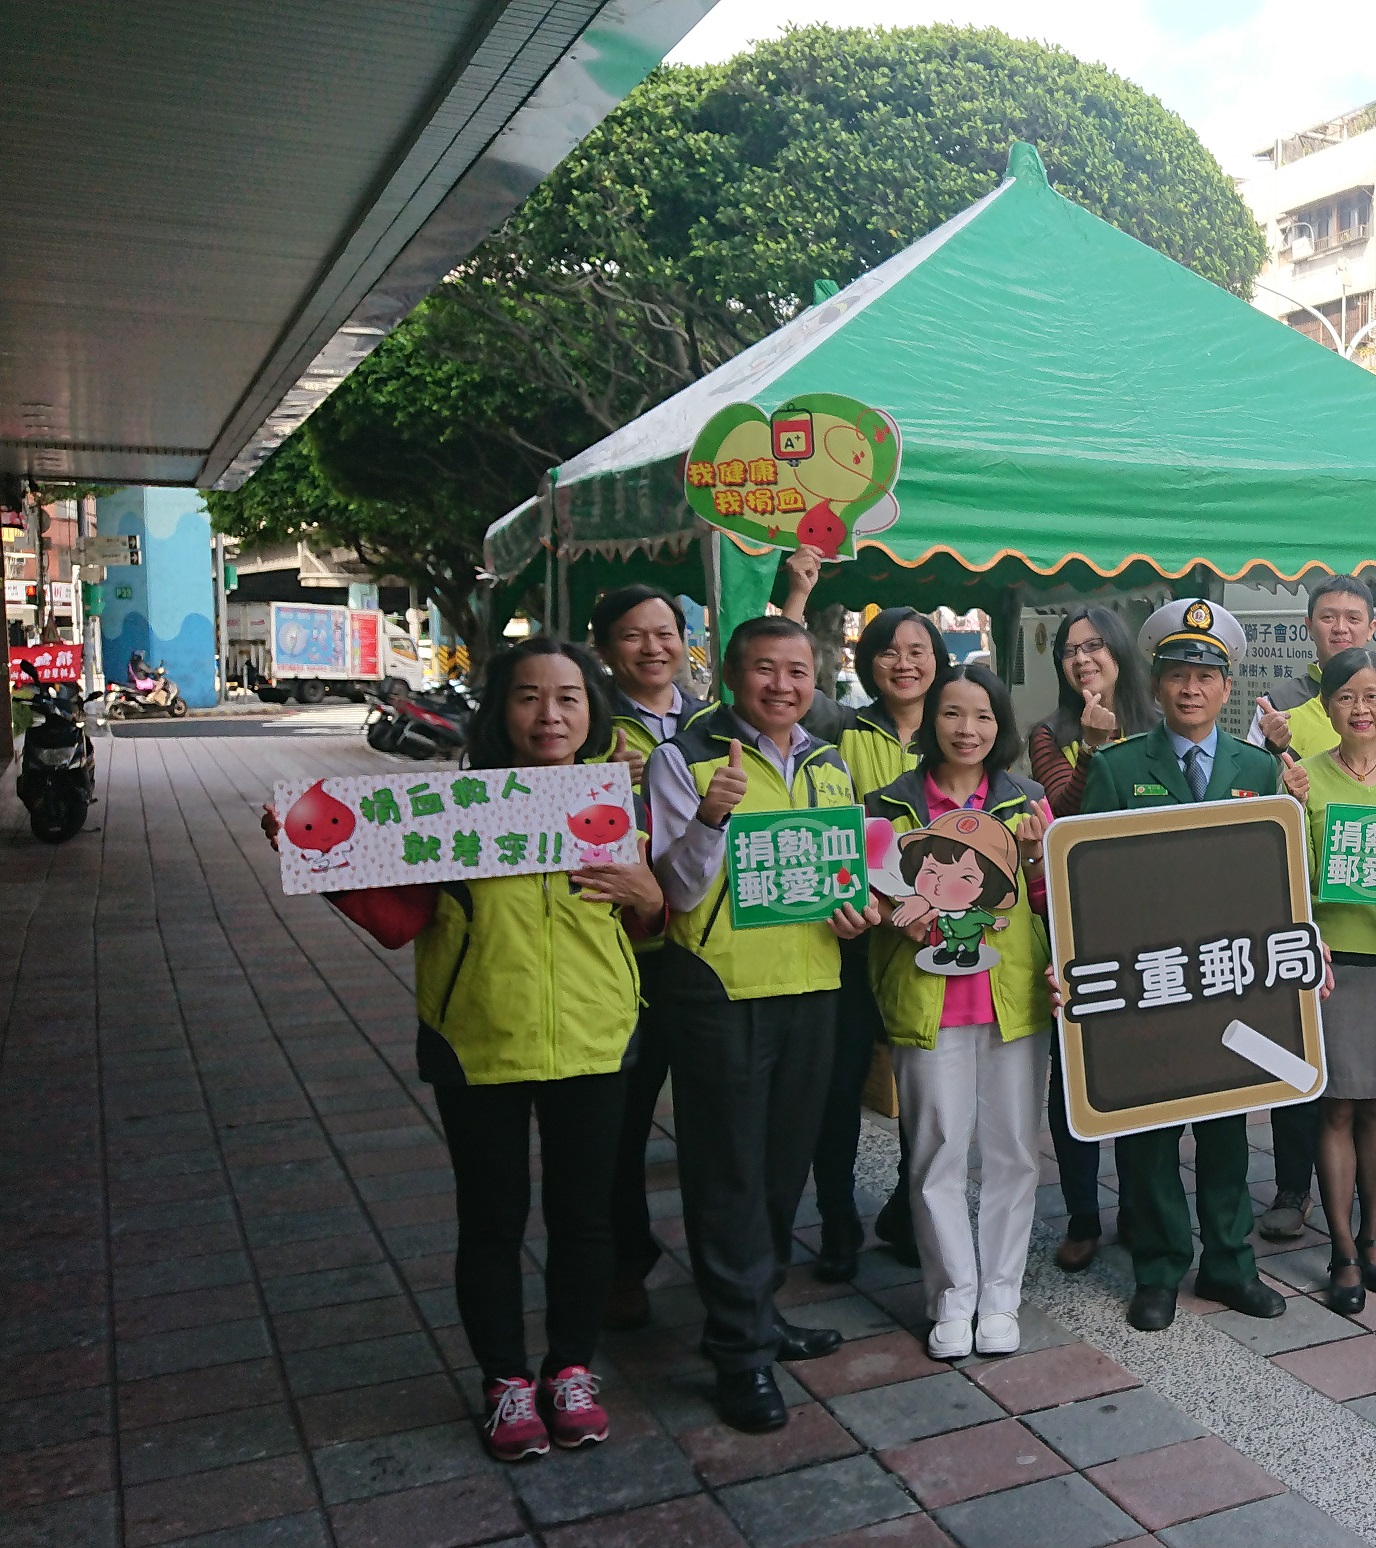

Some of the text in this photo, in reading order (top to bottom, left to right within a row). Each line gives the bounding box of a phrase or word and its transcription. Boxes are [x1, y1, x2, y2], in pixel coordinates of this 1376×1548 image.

[687, 458, 778, 487] 我健康
[714, 487, 806, 515] 我捐血
[1245, 623, 1315, 643] 獅子會30
[1251, 647, 1284, 659] 300A1
[1286, 647, 1313, 660] Lions
[360, 771, 531, 826] 捐血救人
[734, 826, 859, 870] 捐熱血
[737, 867, 862, 908] 郵愛心
[1071, 929, 1317, 1016] 三重郵局
